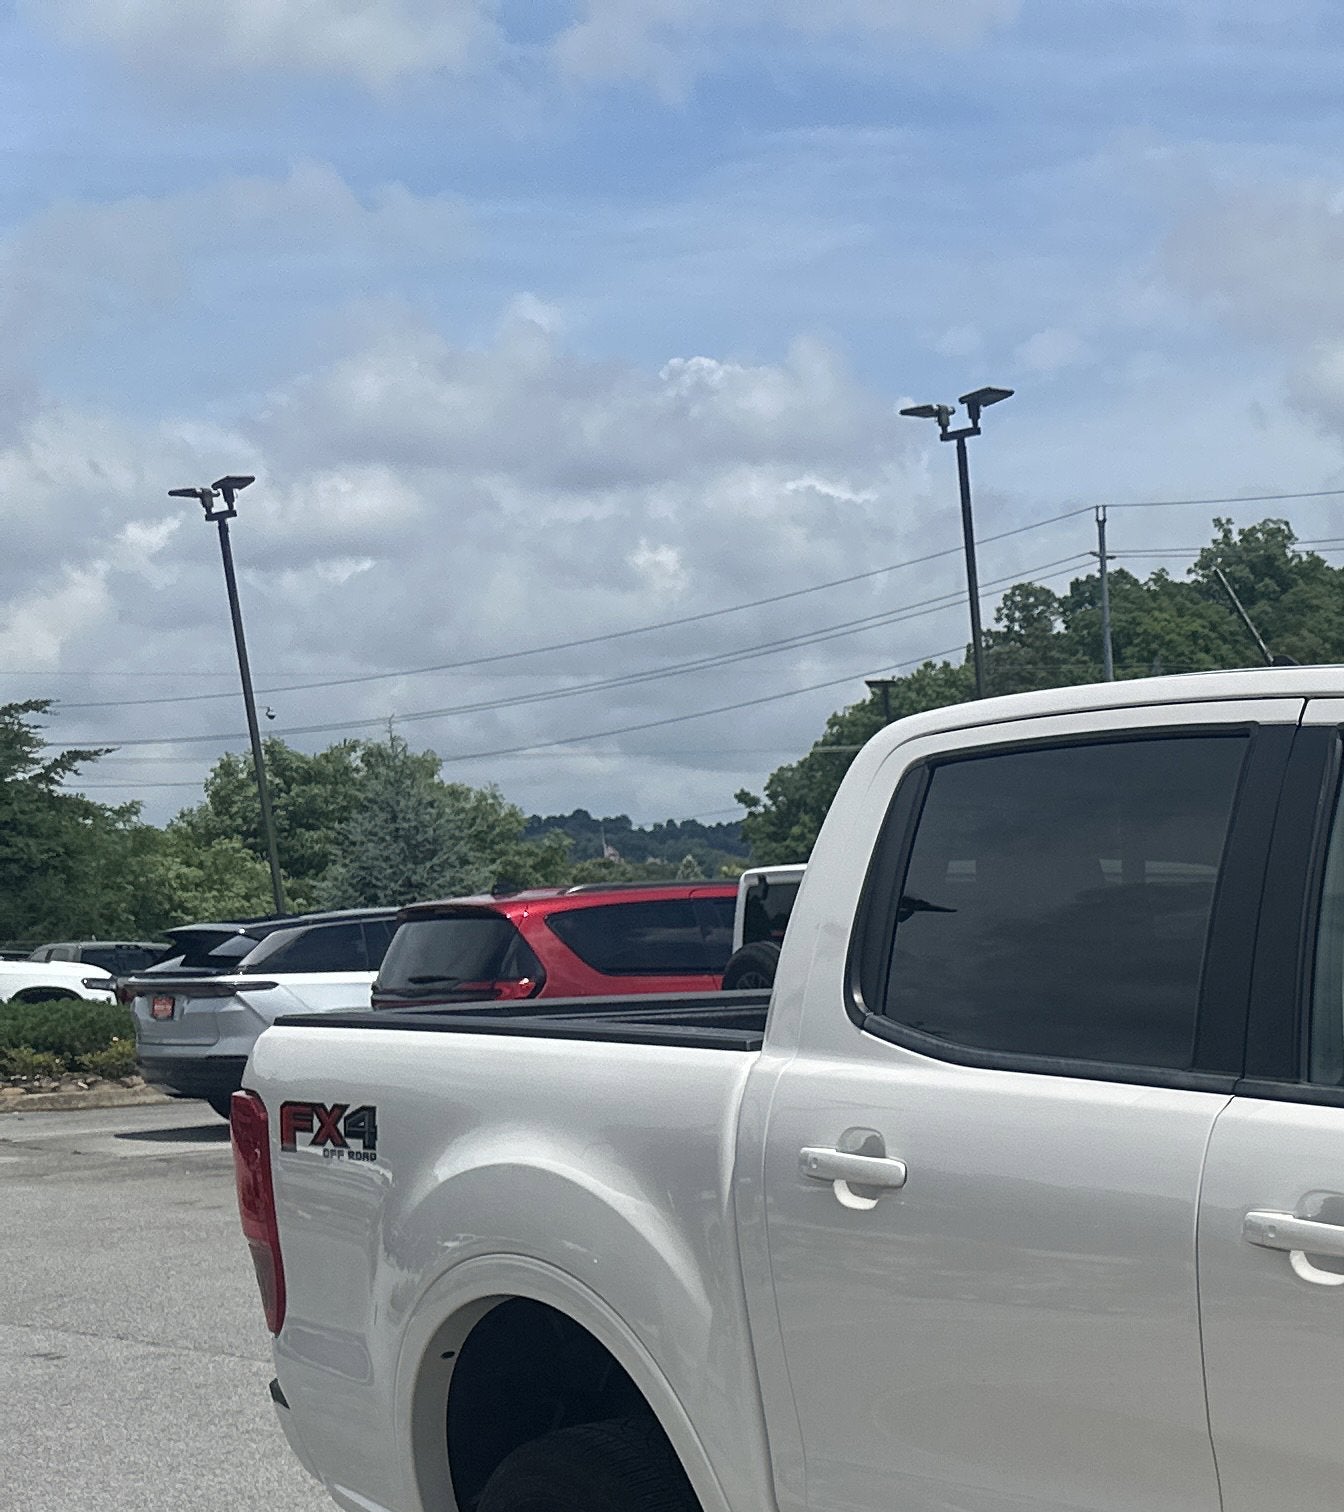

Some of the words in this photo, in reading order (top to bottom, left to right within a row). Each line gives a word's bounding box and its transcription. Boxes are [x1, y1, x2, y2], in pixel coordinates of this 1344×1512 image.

[280, 1100, 378, 1153] FX4
[322, 1148, 345, 1160] OFF
[347, 1150, 377, 1162] ROAD
